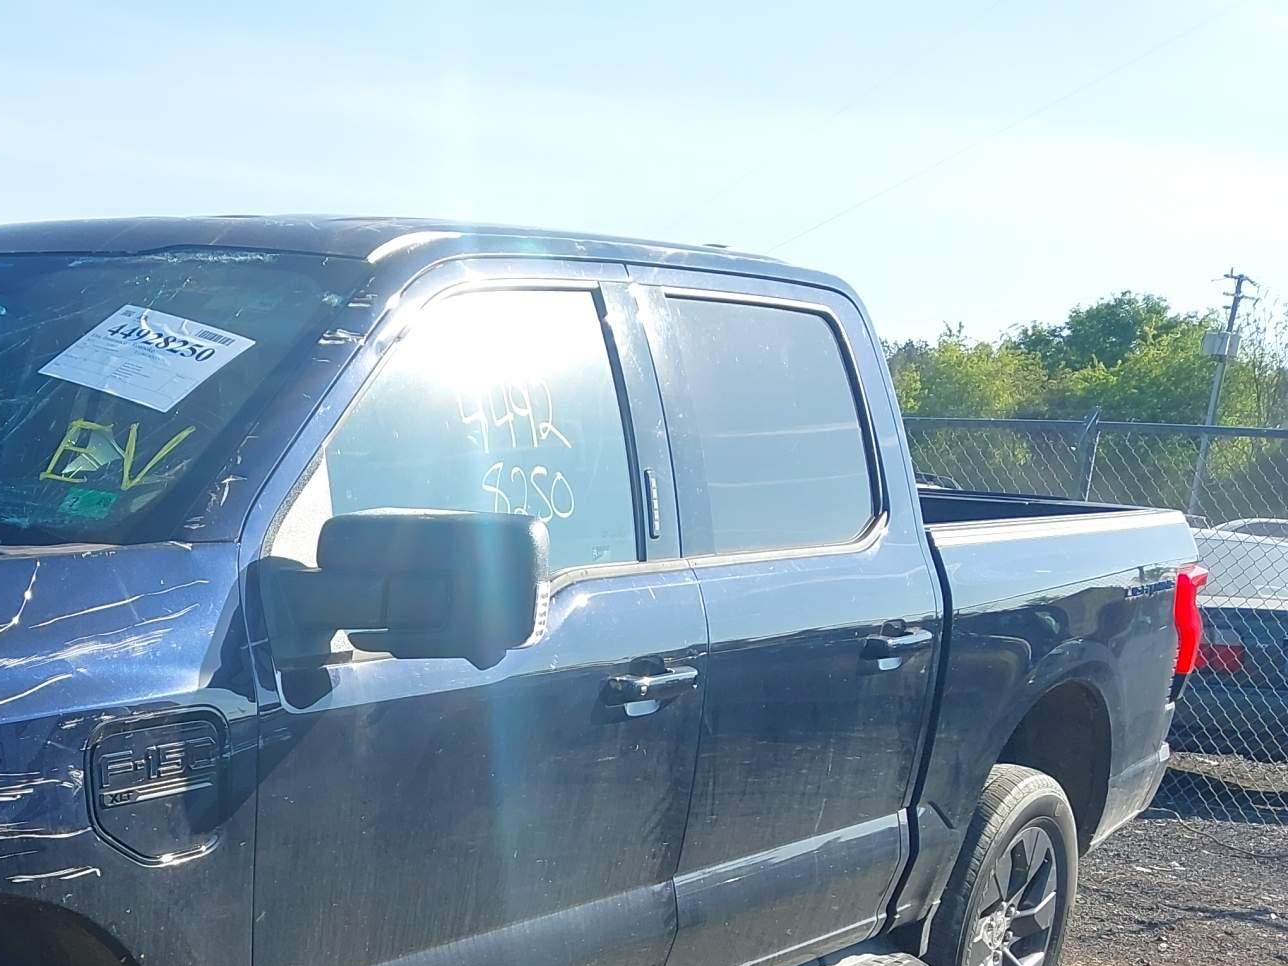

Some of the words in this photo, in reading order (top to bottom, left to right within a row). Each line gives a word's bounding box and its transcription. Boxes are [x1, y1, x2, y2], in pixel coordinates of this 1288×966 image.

[107, 323, 216, 362] 44928250
[456, 379, 572, 454] 4492
[39, 418, 196, 491] EV
[482, 461, 575, 523] 8250
[99, 736, 215, 789] F-150
